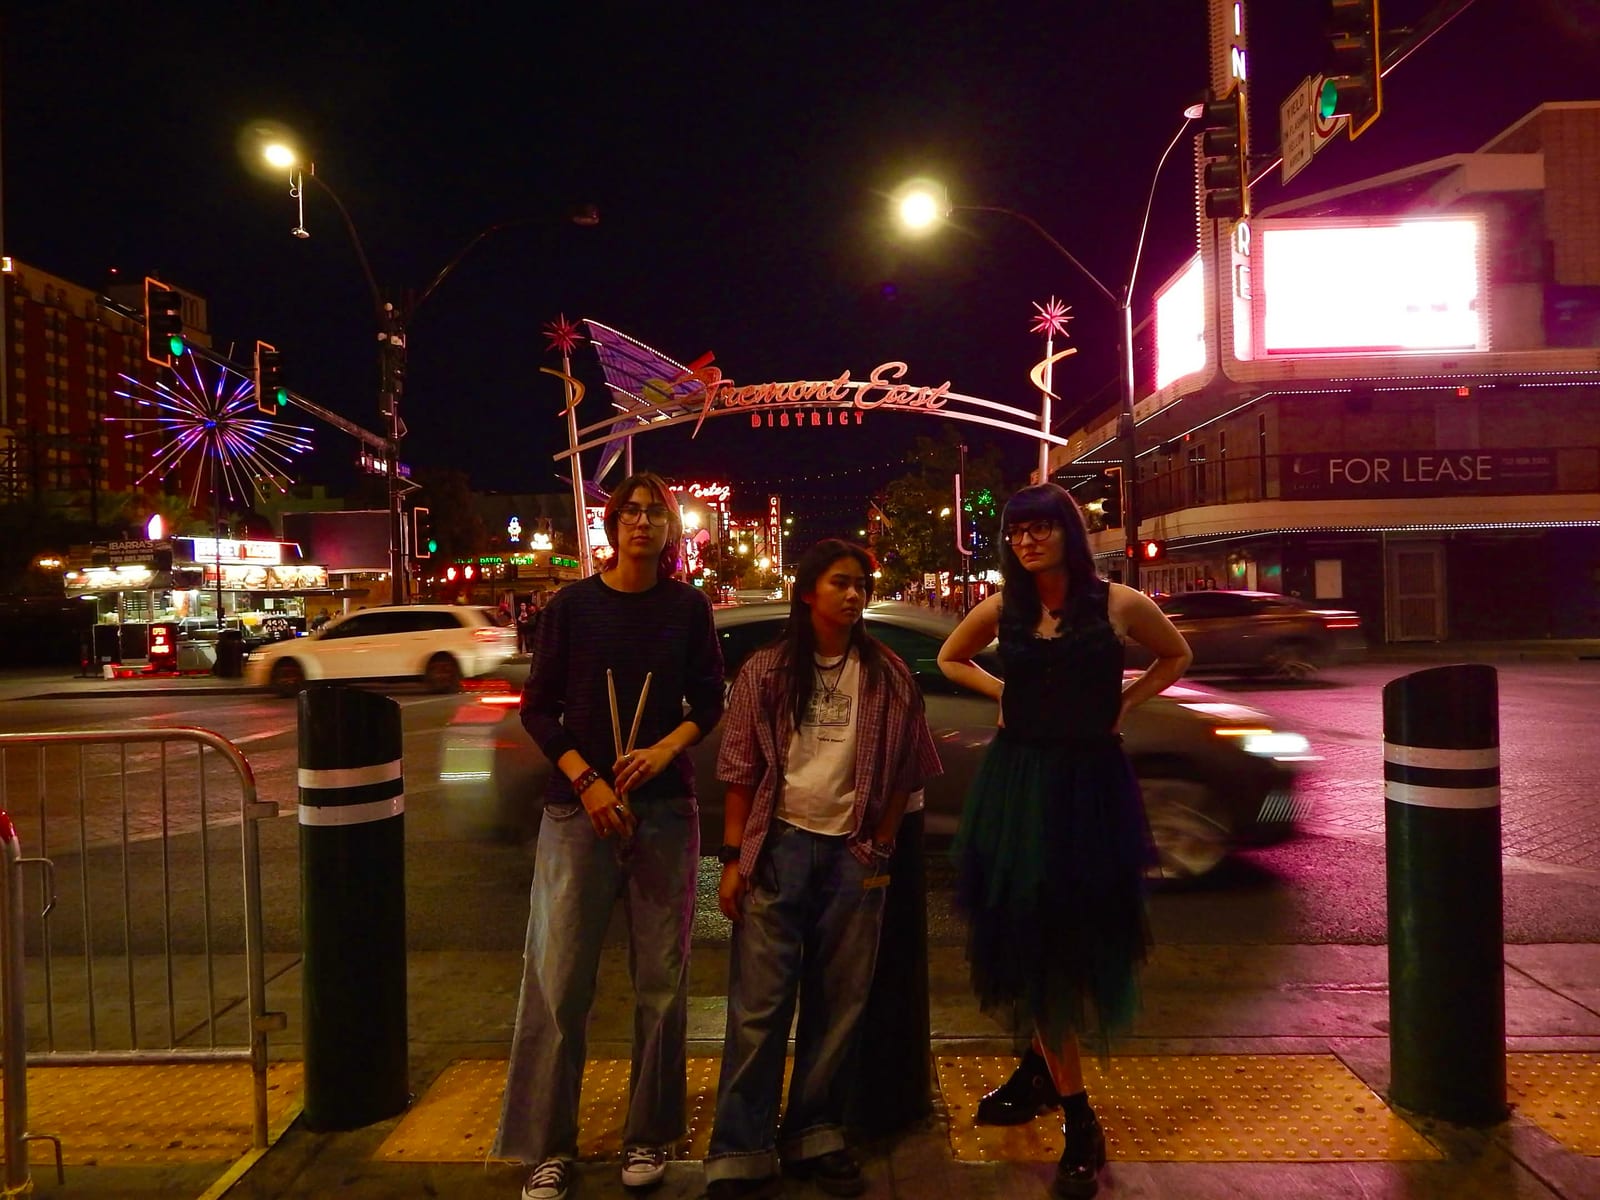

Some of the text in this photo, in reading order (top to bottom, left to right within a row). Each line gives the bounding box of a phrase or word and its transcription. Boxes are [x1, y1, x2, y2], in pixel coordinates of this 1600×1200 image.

[1286, 93, 1304, 118] YIELD
[692, 361, 951, 440] Fremont East
[751, 410, 864, 428] DISTRICT
[1329, 455, 1493, 484] FOR LEASE
[688, 482, 731, 501] Cortez
[108, 540, 154, 550] IBARRA'S
[770, 496, 778, 574] GAMBLING
